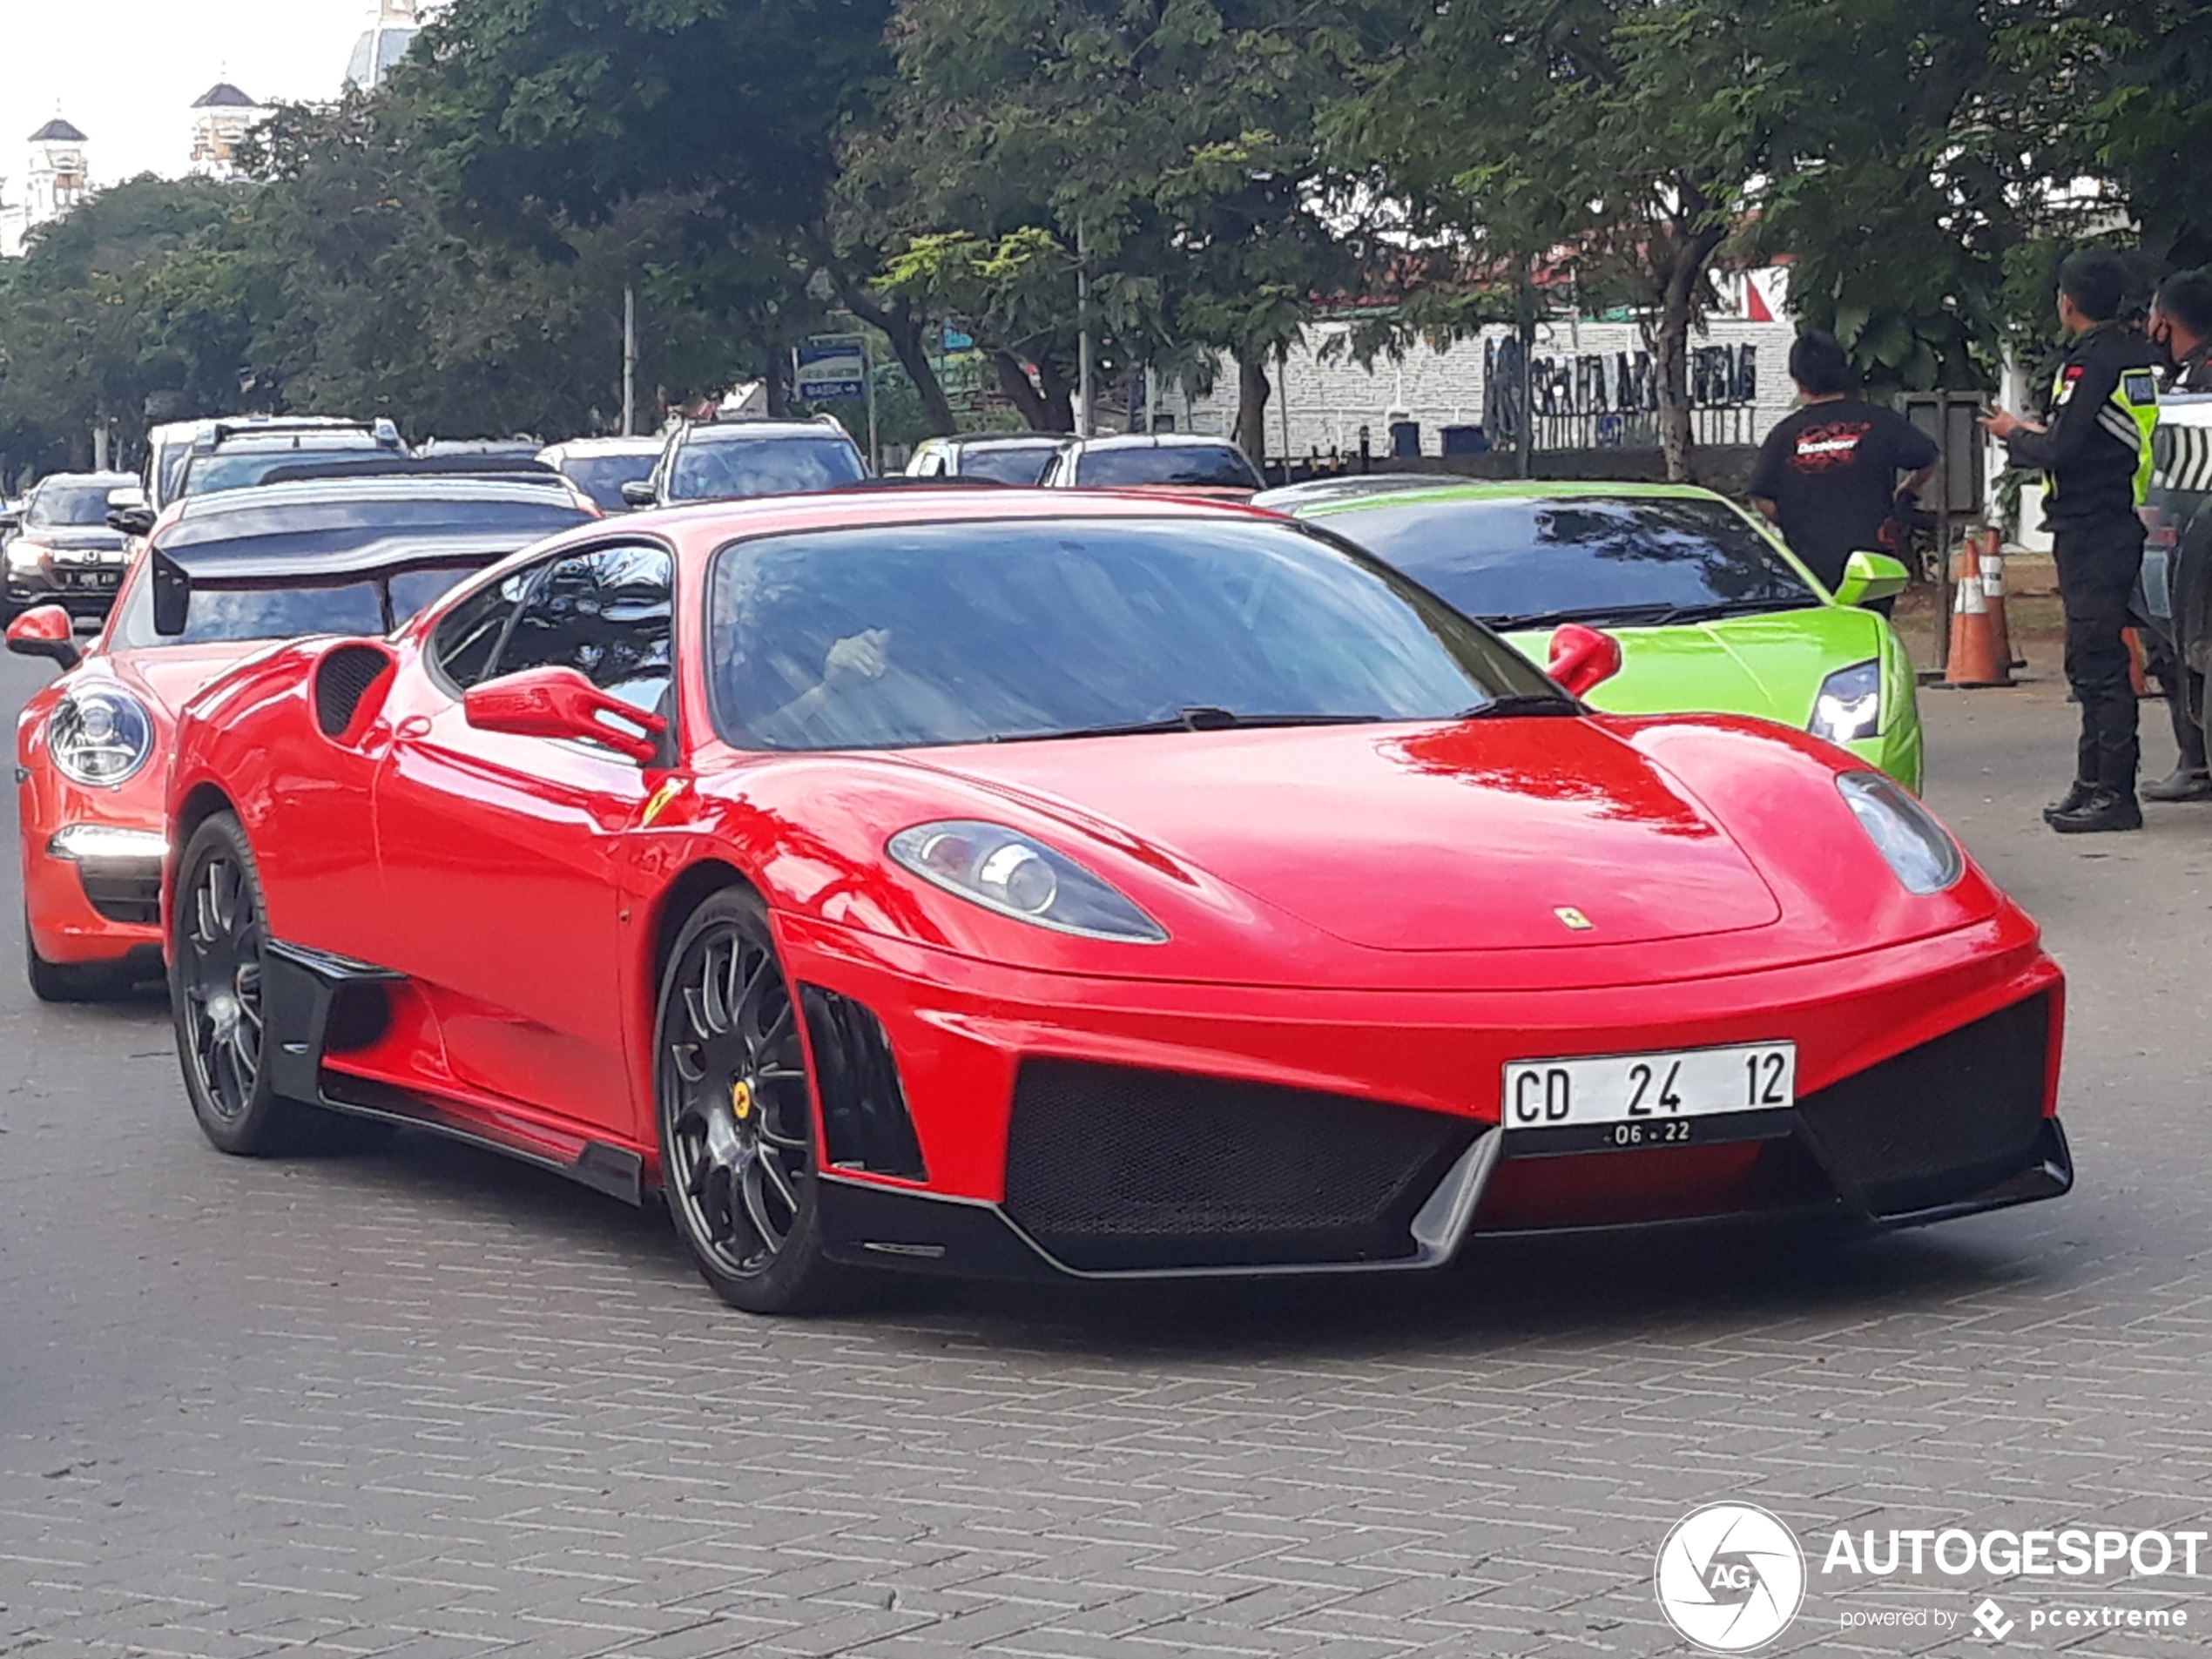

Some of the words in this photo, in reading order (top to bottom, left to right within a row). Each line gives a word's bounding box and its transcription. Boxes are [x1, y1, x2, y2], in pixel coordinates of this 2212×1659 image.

[1516, 1069, 1569, 1122] CD
[1629, 1060, 1682, 1116] 24
[1746, 1052, 1784, 1105] 12
[1615, 1125, 1642, 1144] 06
[1665, 1122, 1689, 1140] 22
